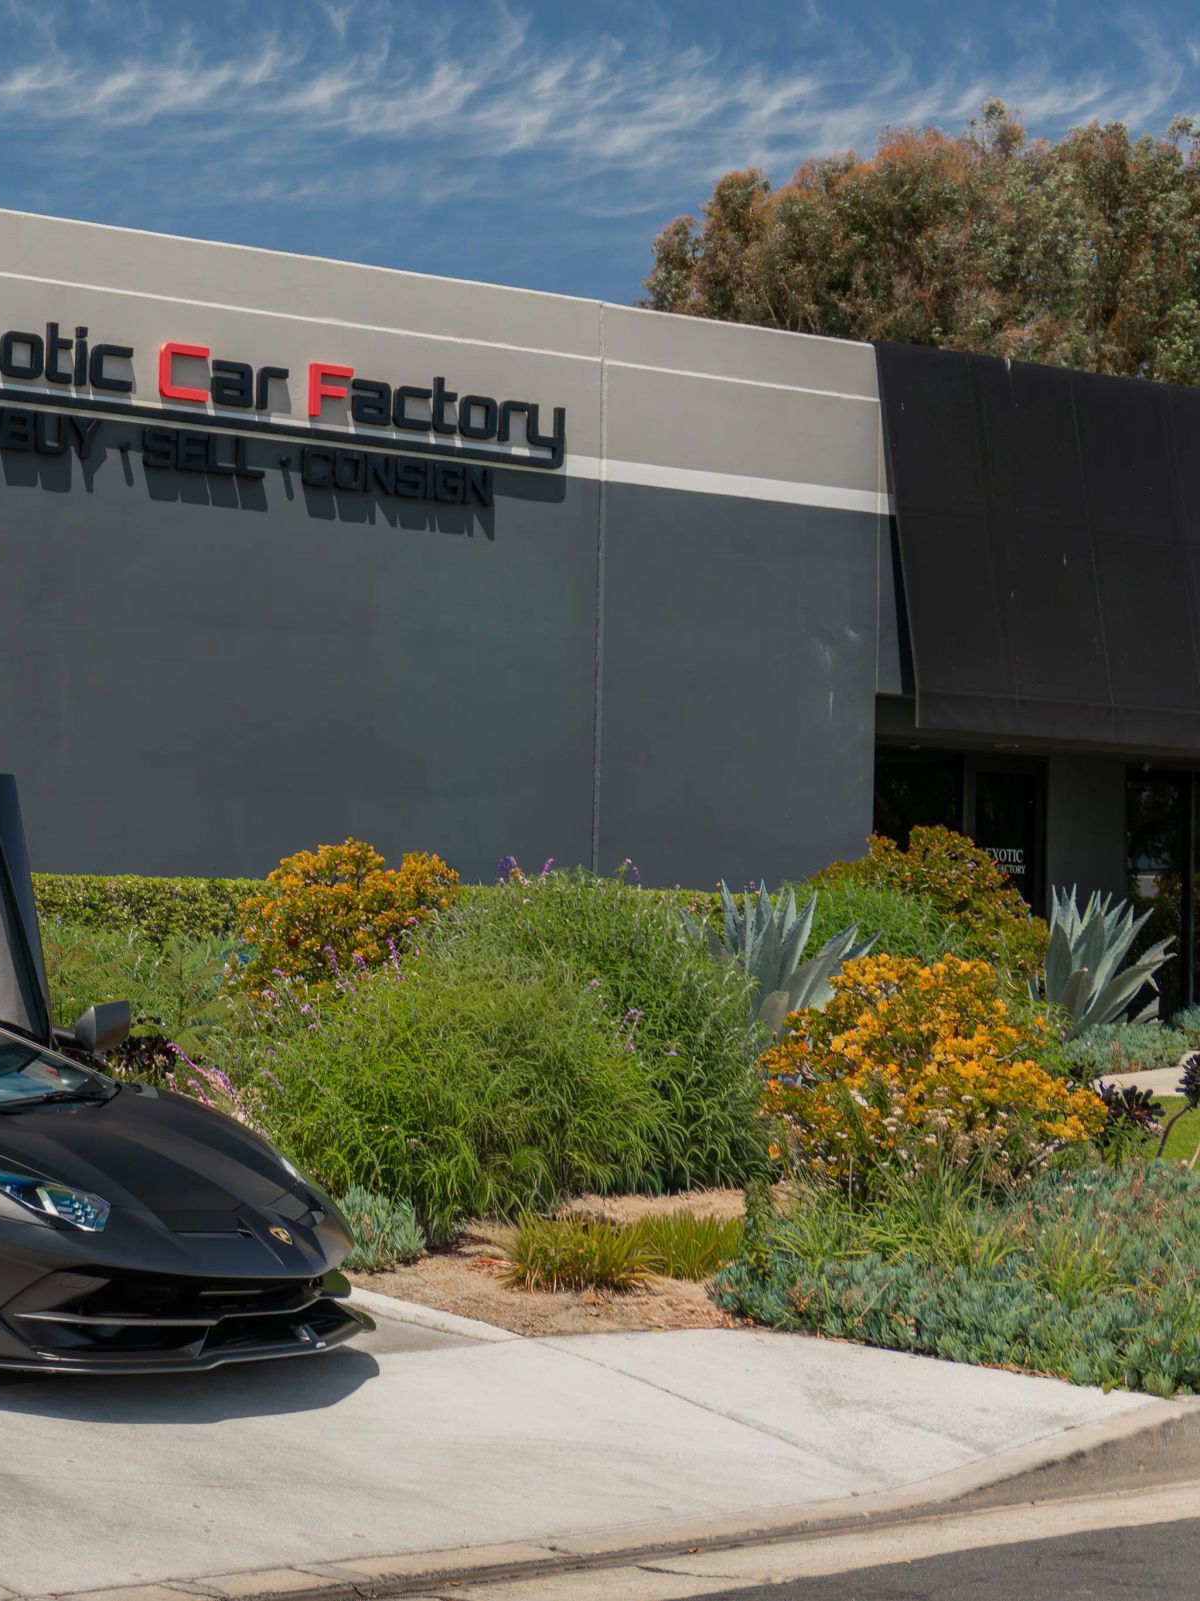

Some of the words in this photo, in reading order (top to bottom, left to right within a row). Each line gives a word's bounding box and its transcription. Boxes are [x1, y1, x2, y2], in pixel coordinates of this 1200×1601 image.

[159, 342, 289, 410] Car
[308, 362, 567, 469] Factory
[0, 409, 101, 459] BUY
[142, 424, 266, 479] SELL
[301, 447, 495, 507] CONSIGN
[985, 847, 1024, 863] EXOTIC
